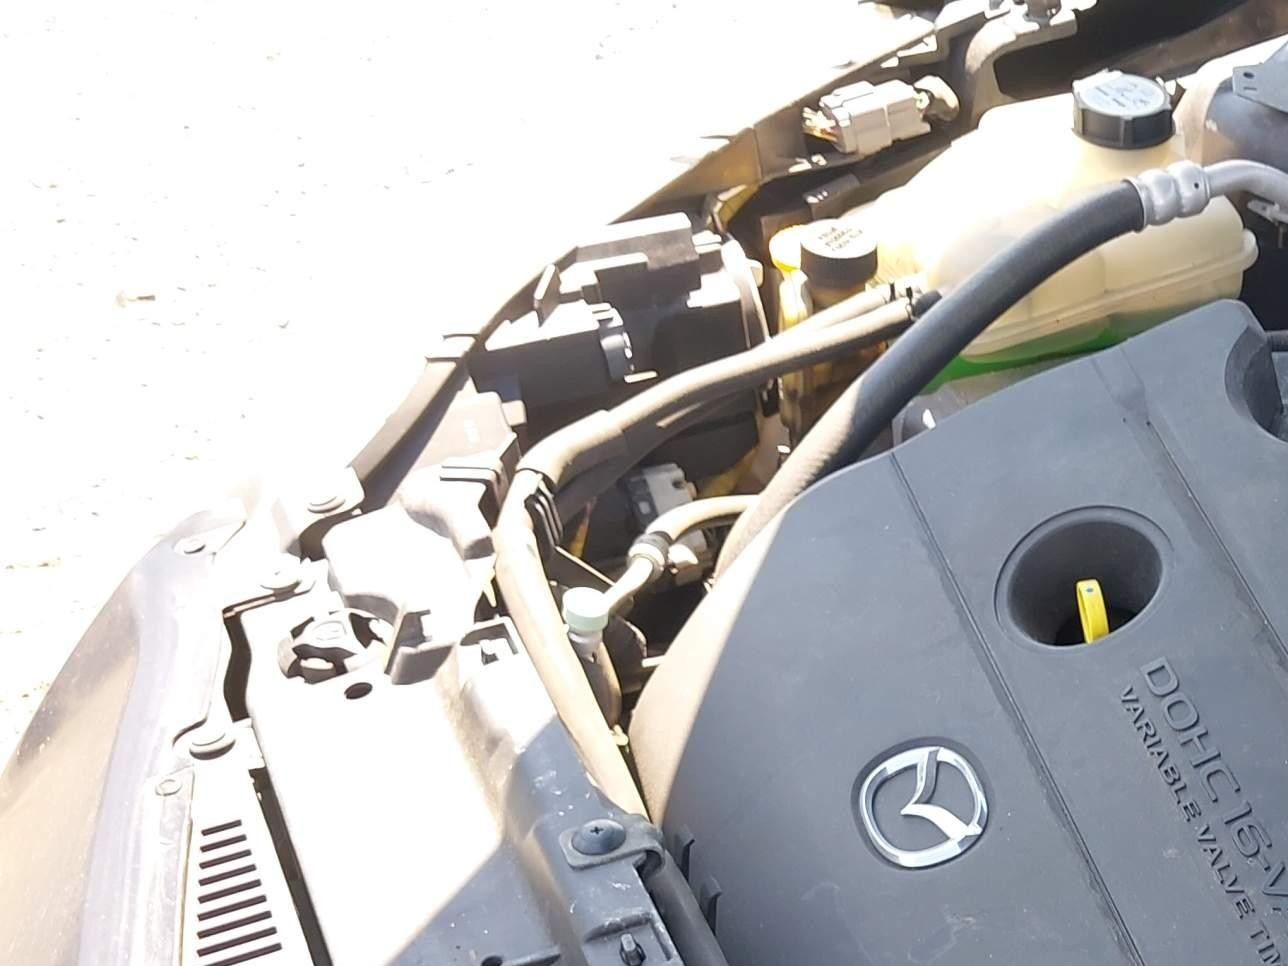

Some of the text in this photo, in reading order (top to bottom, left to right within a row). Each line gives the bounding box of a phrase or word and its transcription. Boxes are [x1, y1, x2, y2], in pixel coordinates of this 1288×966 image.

[1118, 684, 1201, 822] VARIABLE
[1197, 825, 1255, 919] VALVE
[1139, 655, 1241, 803] DOHC
